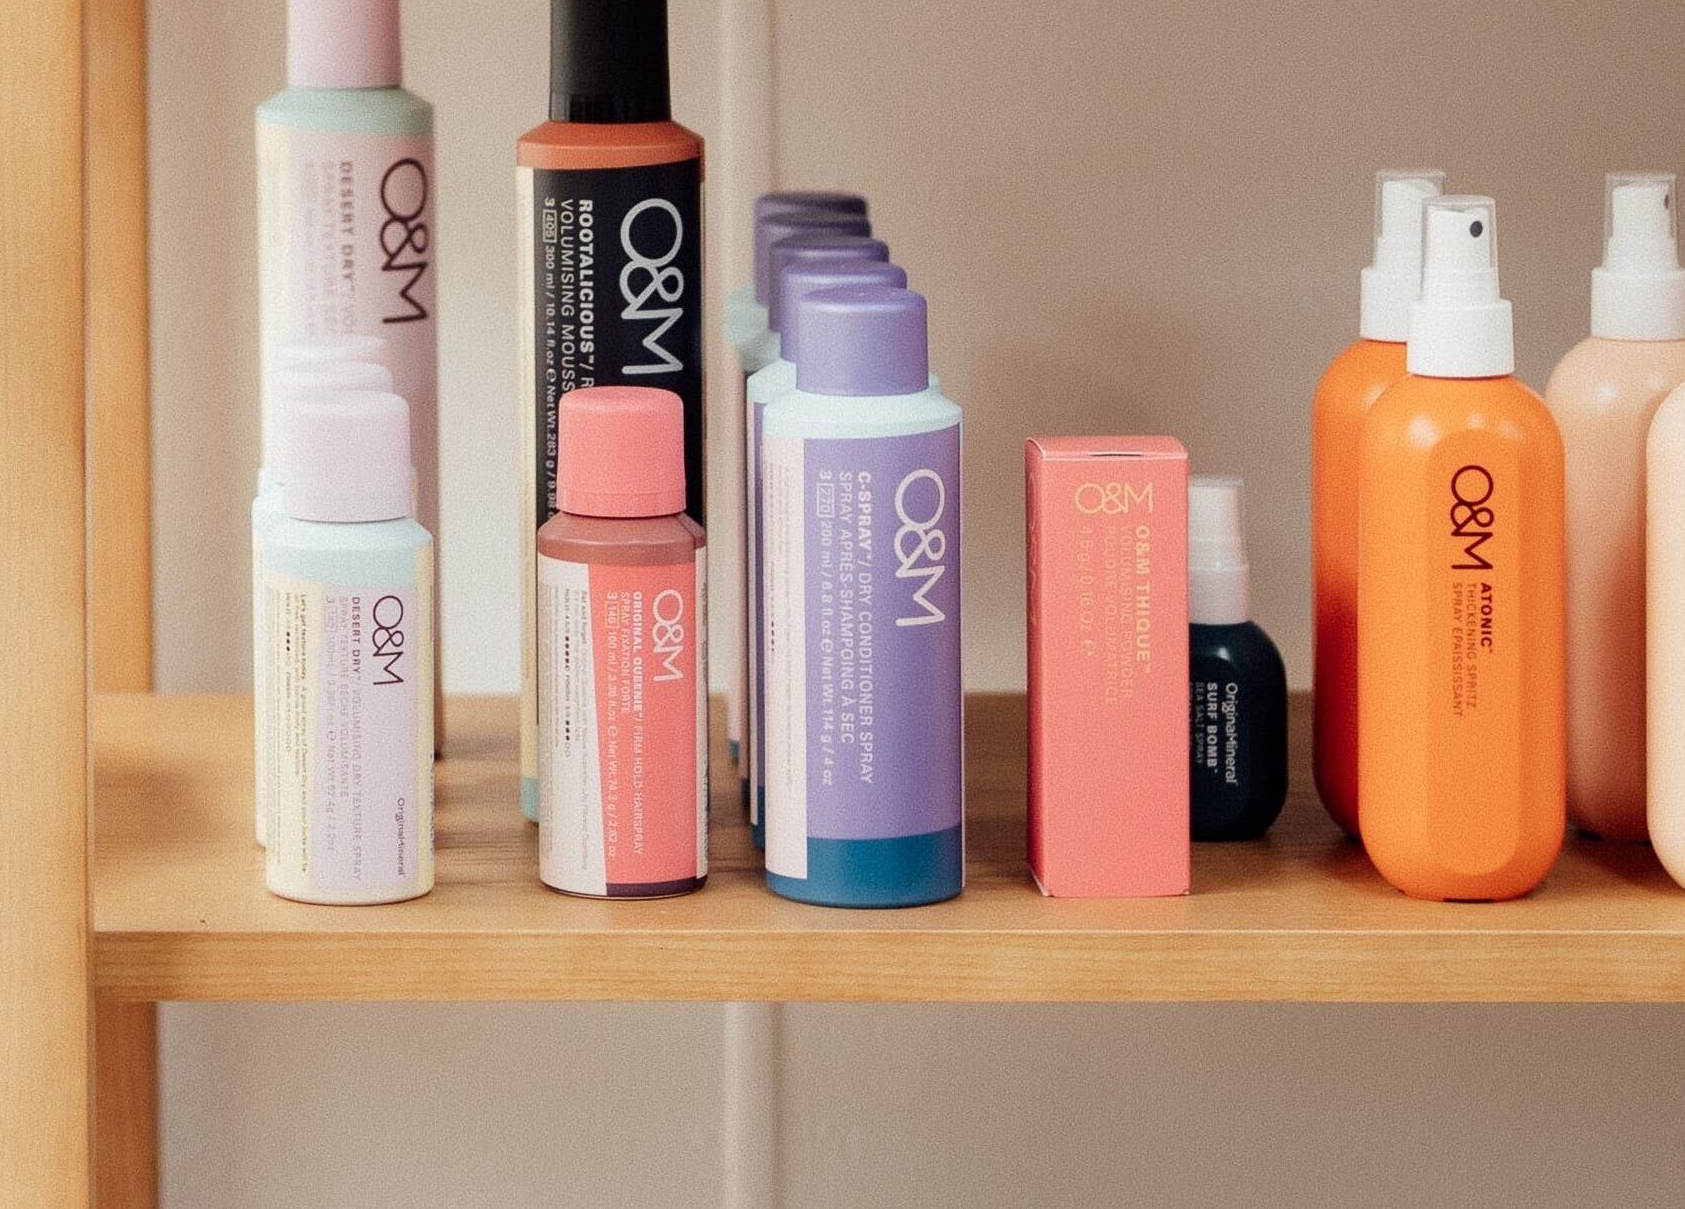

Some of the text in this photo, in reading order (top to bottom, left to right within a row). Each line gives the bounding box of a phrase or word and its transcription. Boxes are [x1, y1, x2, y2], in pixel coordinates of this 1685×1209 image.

[340, 160, 355, 234] DESERT
[545, 197, 556, 207] 3
[379, 158, 428, 324] O&M
[545, 245, 556, 269] 300
[545, 273, 556, 288] ml
[561, 199, 576, 392] VOLUMISING MOUSS
[619, 198, 684, 375] O&M
[545, 303, 556, 334] 10.14
[545, 386, 556, 407] Net
[839, 471, 853, 523] SPRAY
[1074, 481, 1154, 514] O&M
[1450, 465, 1494, 570] O&M
[820, 521, 832, 546] 200
[894, 468, 945, 627] O&M
[1136, 525, 1151, 574] O&M
[821, 551, 833, 567] ml
[858, 573, 873, 605] DRY
[1120, 525, 1133, 699] VOLUMISING POWDER
[352, 596, 361, 644] DESERT
[372, 595, 405, 685] O&M
[633, 591, 643, 653] ORIGINAL
[652, 588, 685, 682] O&M
[1104, 525, 1117, 705] POUDRE VOLUMATRICE
[621, 592, 631, 714] SPRAY FIXATION FORTE
[821, 656, 833, 680] Net
[858, 611, 873, 726] CONDITIONER
[1452, 582, 1463, 717] SPRAY EPAISSISSANT
[1466, 583, 1477, 709] THICKENING SPRITZ
[1195, 682, 1204, 764] SEA SALT SPRAY
[1207, 682, 1218, 720] SURF
[634, 726, 644, 753] FIRM
[839, 712, 855, 744] SEC
[633, 757, 644, 788] HOLD
[821, 770, 833, 786] oz
[858, 731, 873, 784] SPRAY
[352, 791, 362, 840] TEXTURE
[634, 793, 644, 855] HAIRSPRAY
[352, 845, 362, 881] SPRAY
